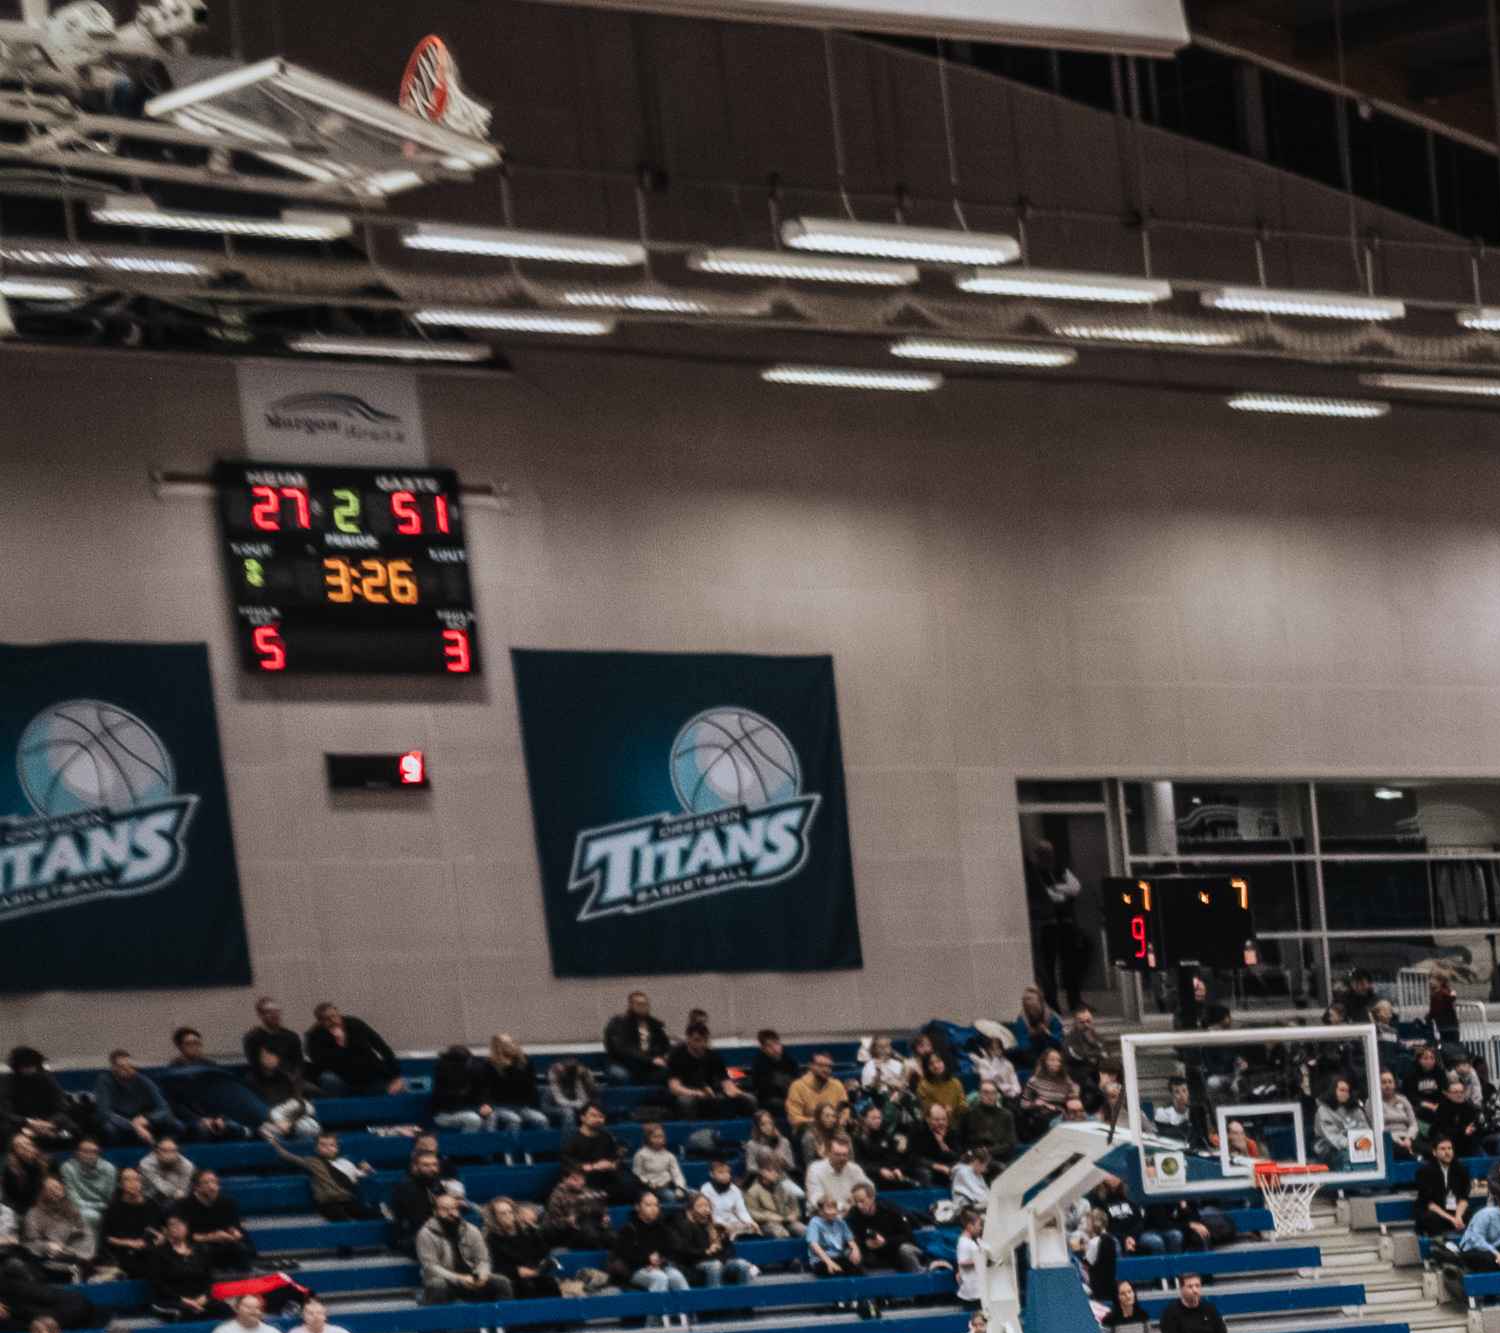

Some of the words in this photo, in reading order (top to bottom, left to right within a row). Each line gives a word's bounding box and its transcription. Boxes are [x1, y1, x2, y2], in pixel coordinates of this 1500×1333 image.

[252, 485, 310, 532] 27
[332, 489, 361, 533] 2
[392, 490, 449, 536] 51
[322, 558, 419, 605] 3:26
[253, 625, 286, 671] 5
[442, 629, 471, 673] 3
[582, 806, 805, 905] TITANS
[636, 867, 748, 902] BASKETBALL
[1131, 915, 1147, 959] 9
